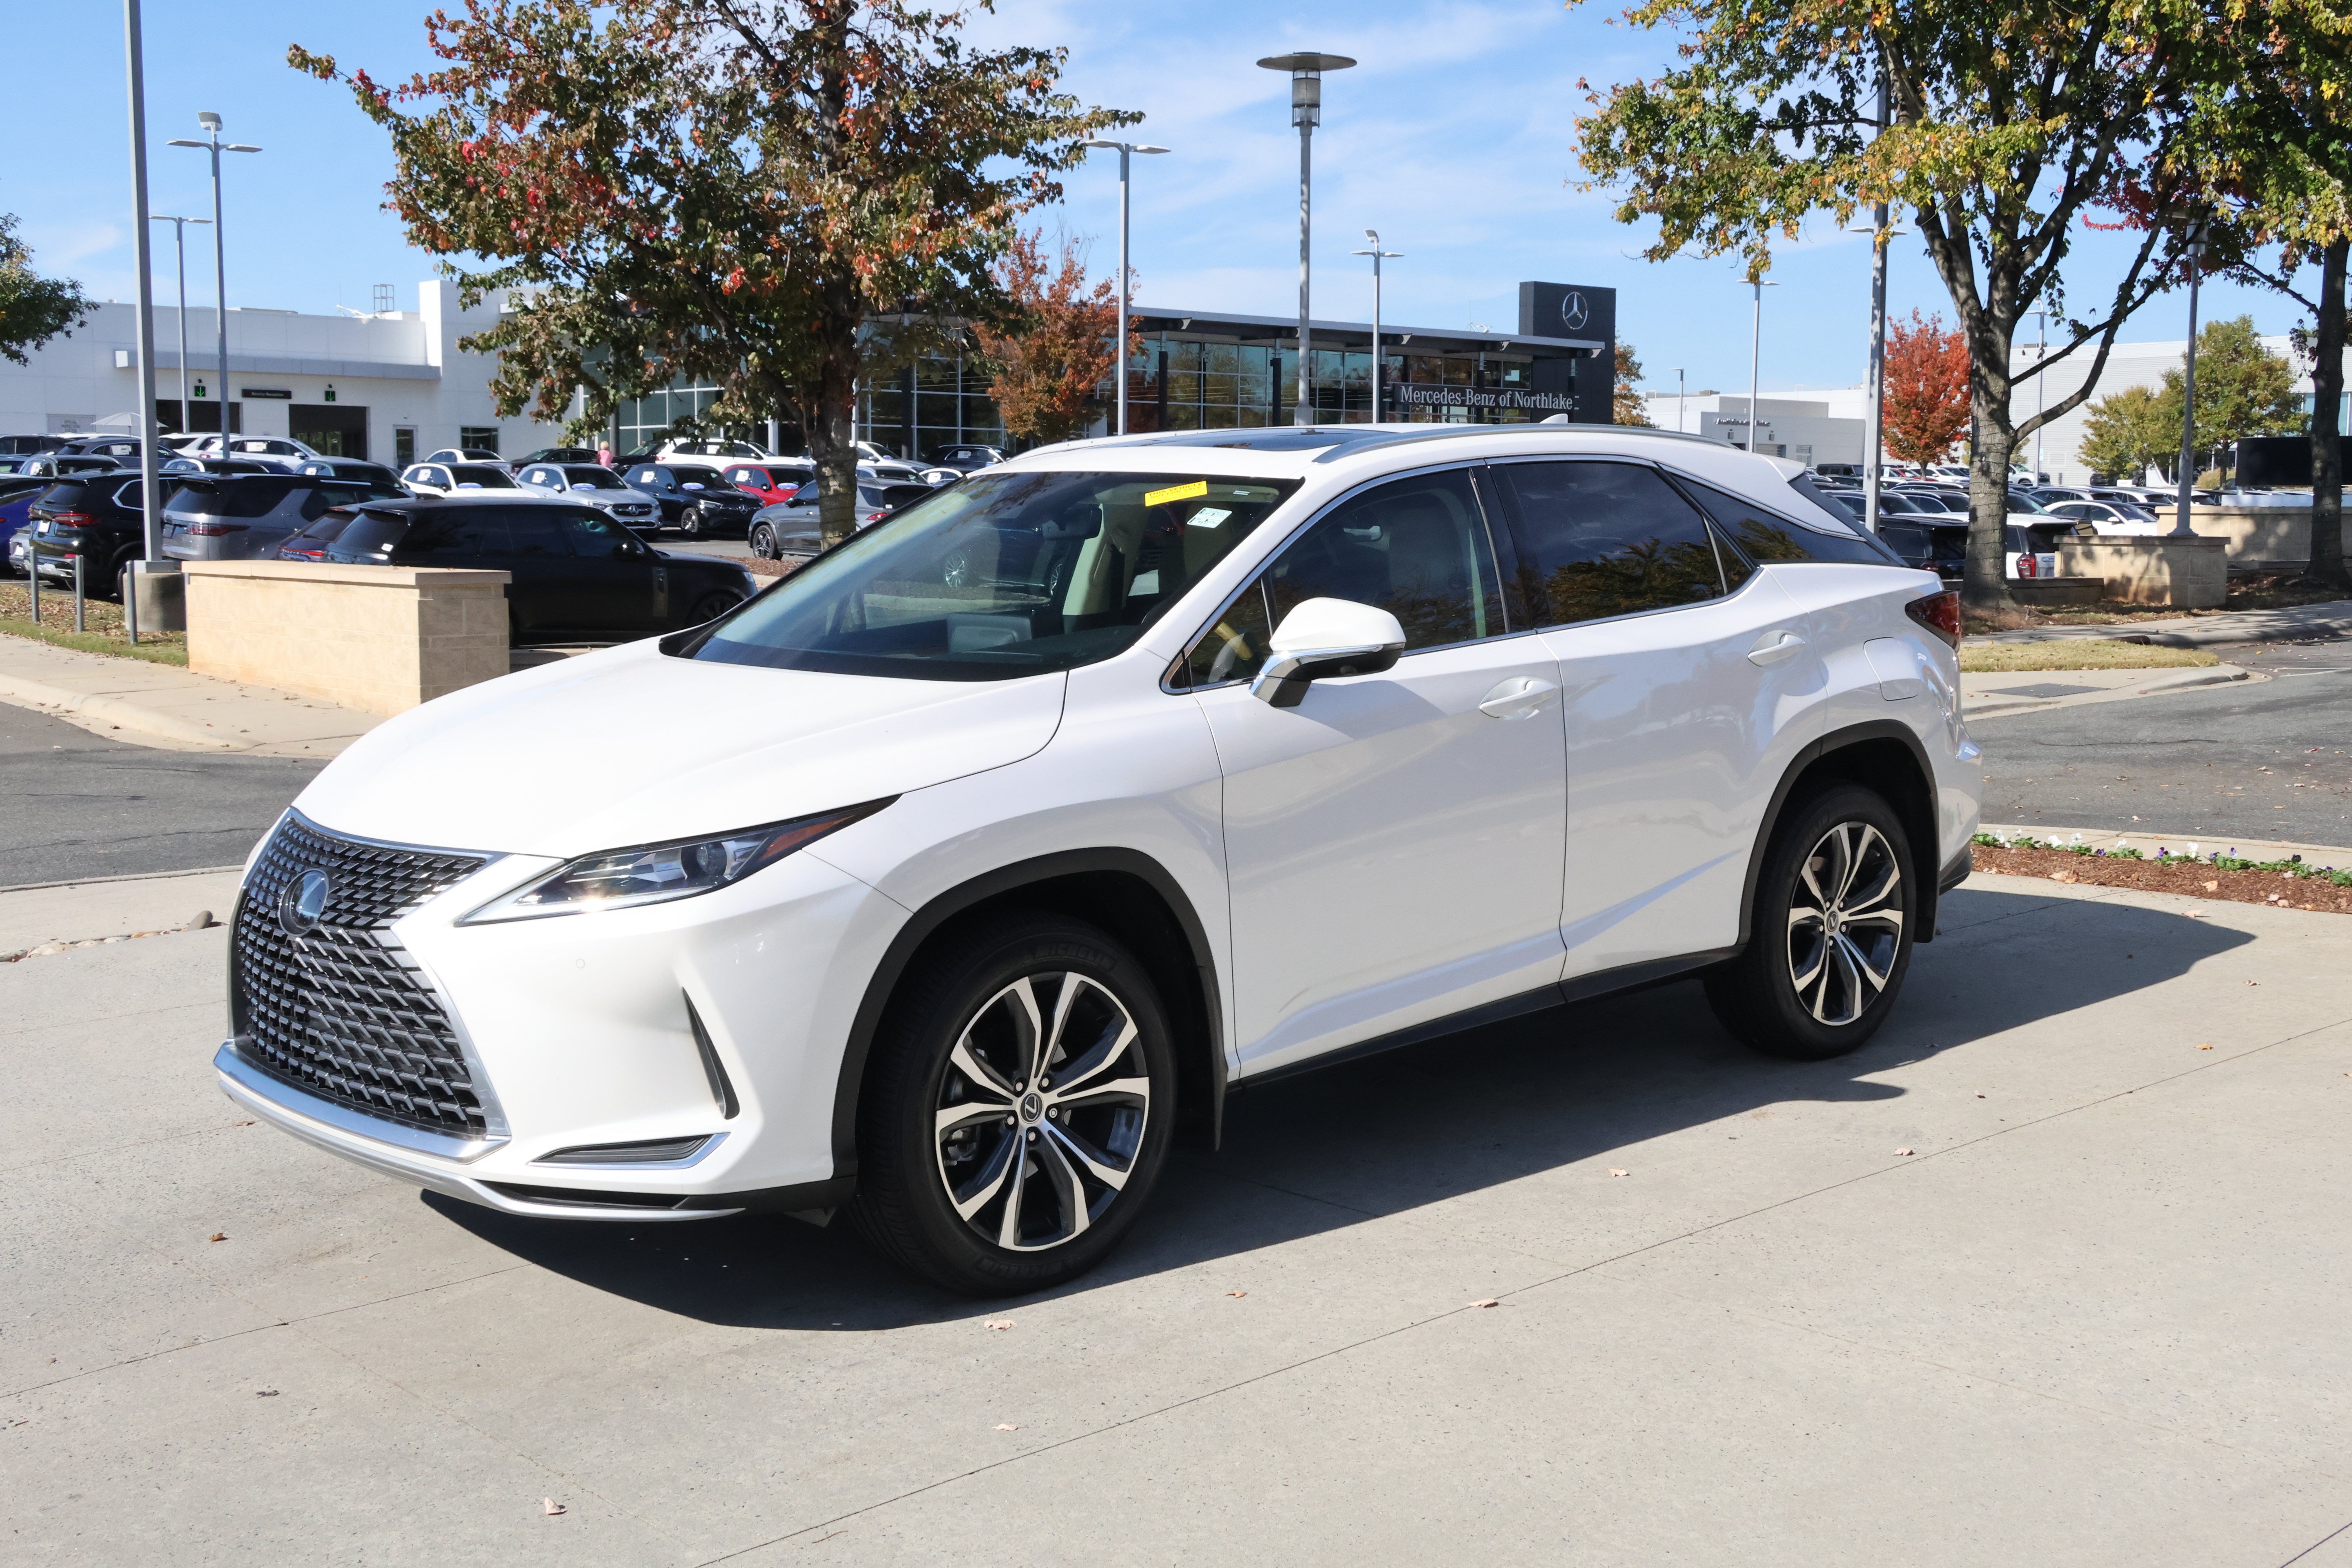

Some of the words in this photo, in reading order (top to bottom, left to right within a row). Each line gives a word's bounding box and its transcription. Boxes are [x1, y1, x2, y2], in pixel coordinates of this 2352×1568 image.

[1400, 386, 1495, 406] Mercedes-Benz
[1499, 390, 1512, 408] of
[1514, 391, 1573, 410] Northlake
[1169, 483, 1203, 491] VEHICLE
